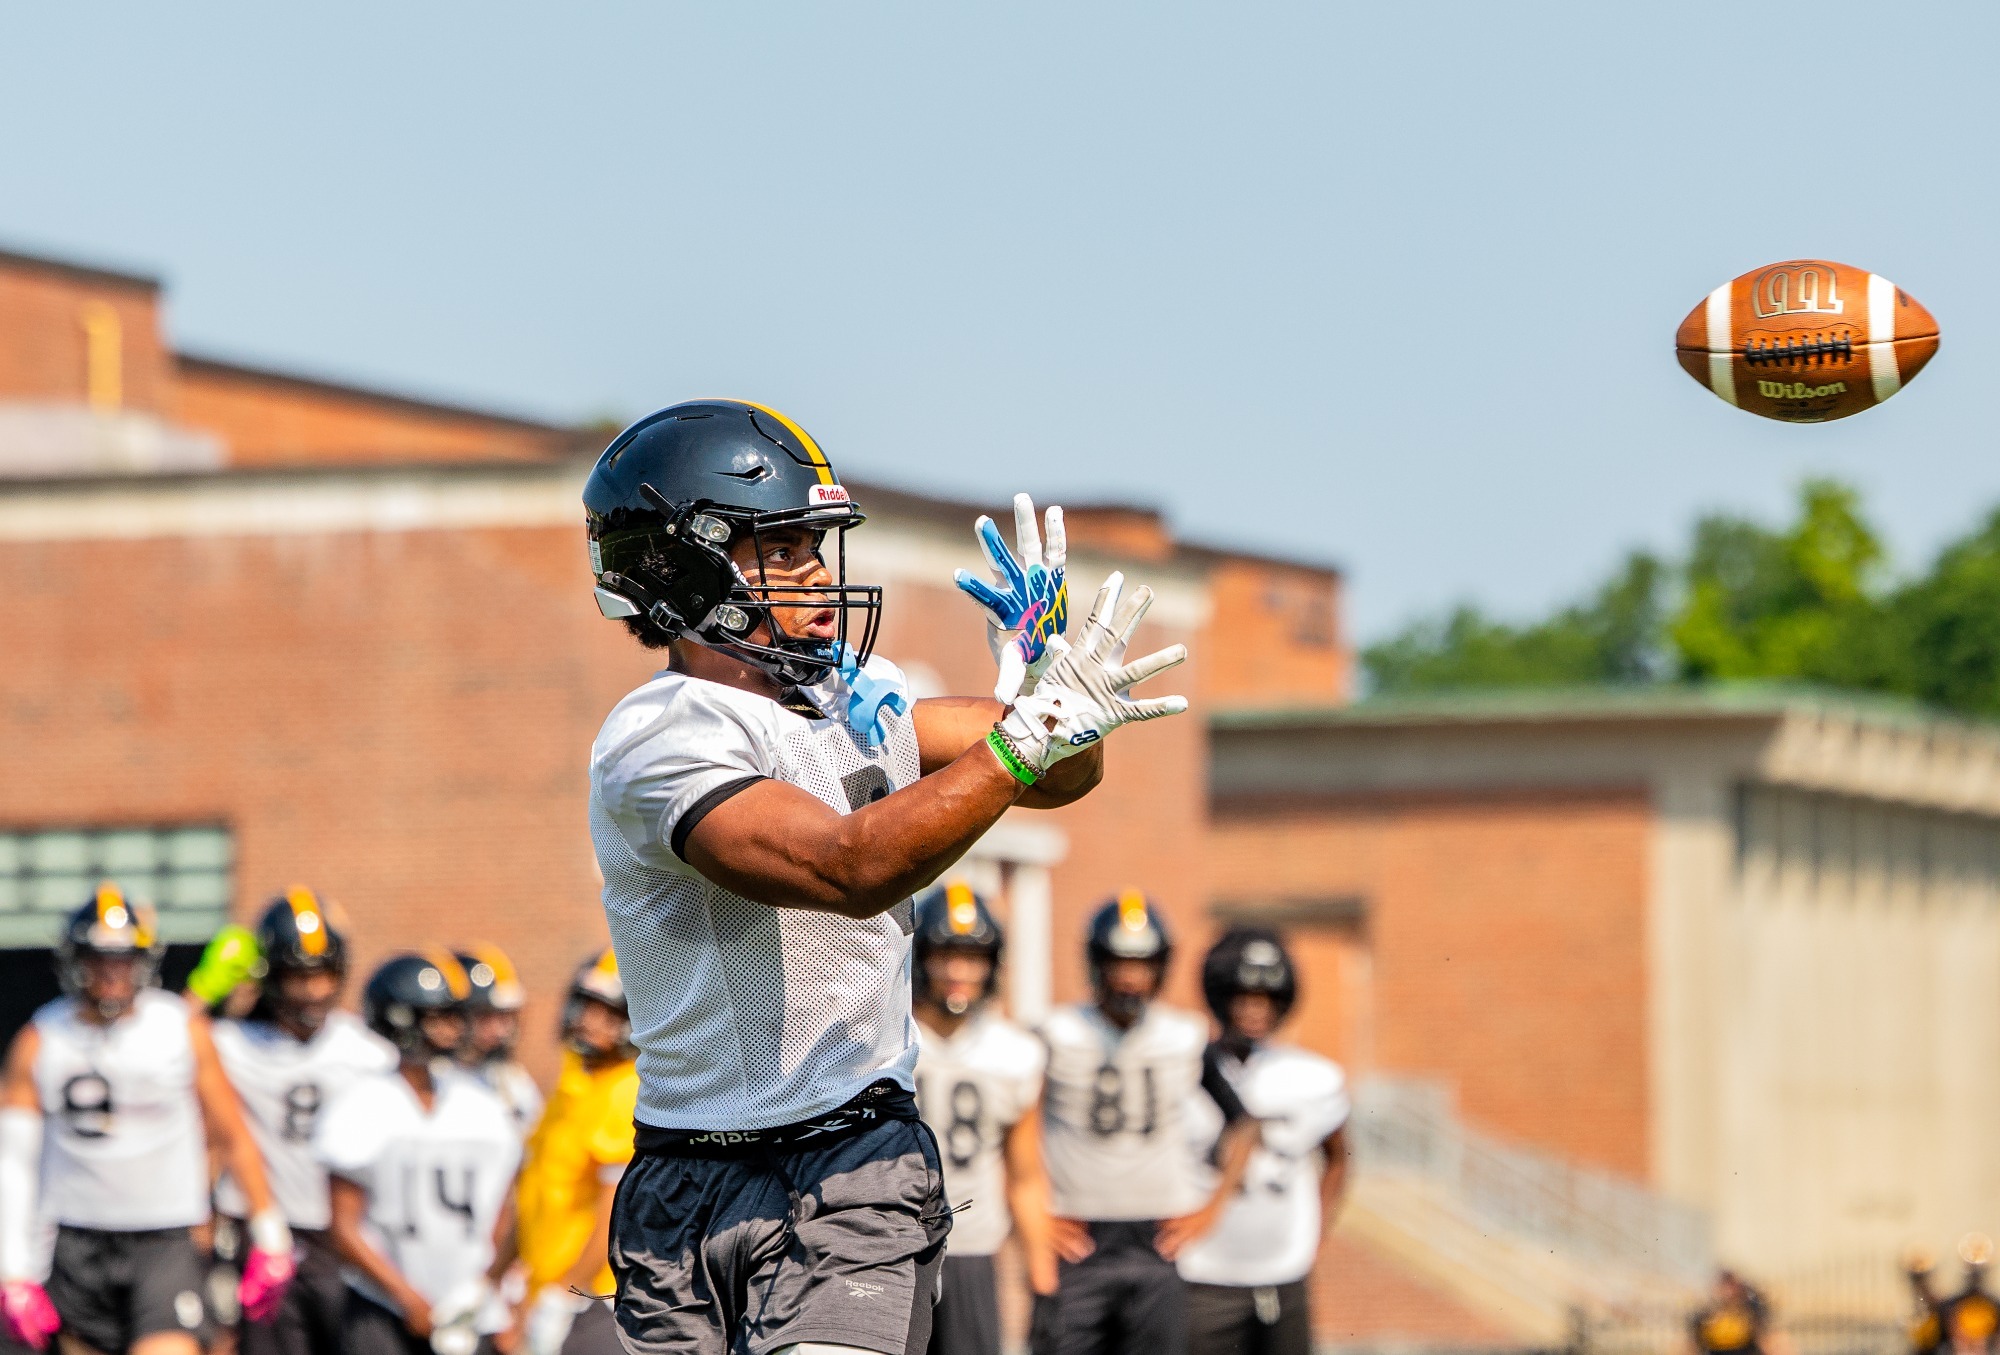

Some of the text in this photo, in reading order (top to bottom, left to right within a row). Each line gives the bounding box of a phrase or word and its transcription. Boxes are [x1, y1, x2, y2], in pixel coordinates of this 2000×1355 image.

[1757, 380, 1847, 399] Wilson
[1092, 1064, 1155, 1137] 81
[845, 1280, 885, 1293] Reebok
